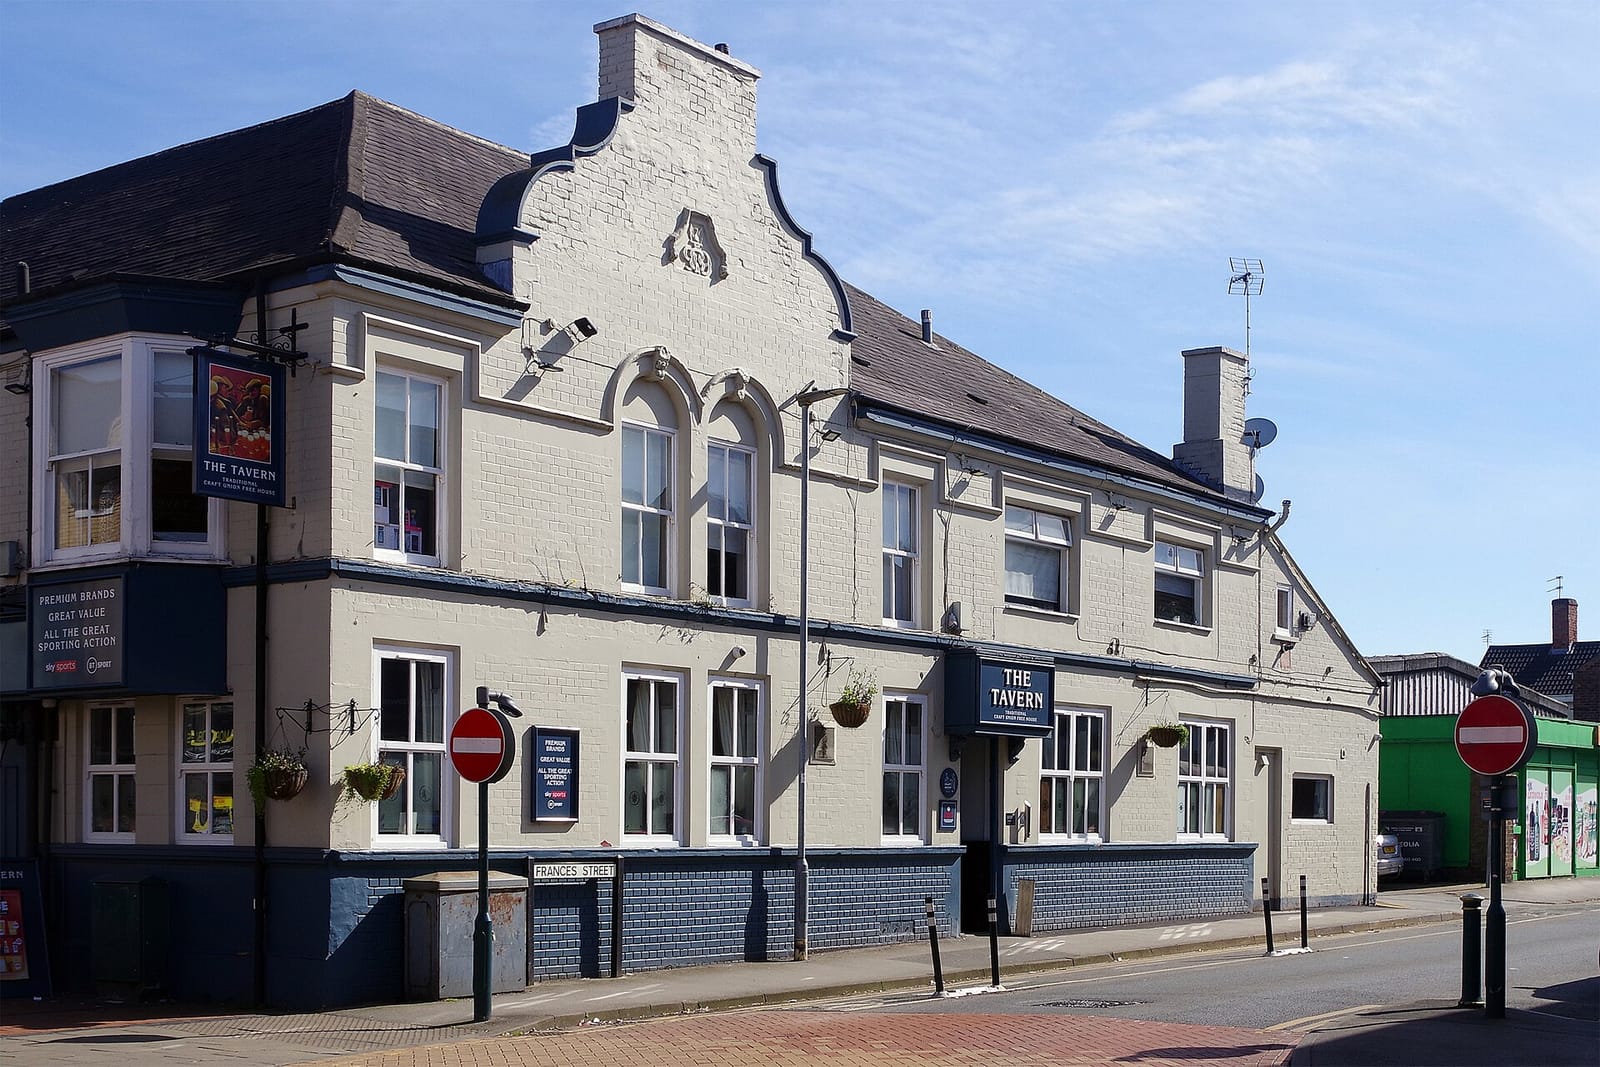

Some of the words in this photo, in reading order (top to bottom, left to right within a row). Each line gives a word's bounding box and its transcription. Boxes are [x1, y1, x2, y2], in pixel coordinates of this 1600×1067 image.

[203, 460, 227, 473] THE
[230, 464, 276, 481] TAVERN
[203, 480, 221, 488] CRAFT
[222, 482, 241, 490] UNION
[241, 485, 257, 493] FREE
[257, 488, 276, 496] HOUSE
[222, 477, 258, 488] TRADITIONAL
[39, 593, 77, 606] PREMIUM
[80, 588, 115, 601] BRANDS
[48, 610, 76, 622] GREAT
[78, 607, 106, 619] VALUE
[44, 630, 60, 639] ALL
[62, 627, 80, 638] THE
[82, 624, 111, 636] GREAT
[38, 640, 80, 652] SPORTING
[83, 636, 116, 648] ACTION
[45, 663, 55, 673] sky
[56, 662, 76, 672] sports
[97, 660, 112, 669] SPORT
[1003, 668, 1031, 687] THE
[991, 688, 1043, 709] TAVERN
[535, 865, 578, 877] FRANCES
[582, 865, 615, 876] STREET
